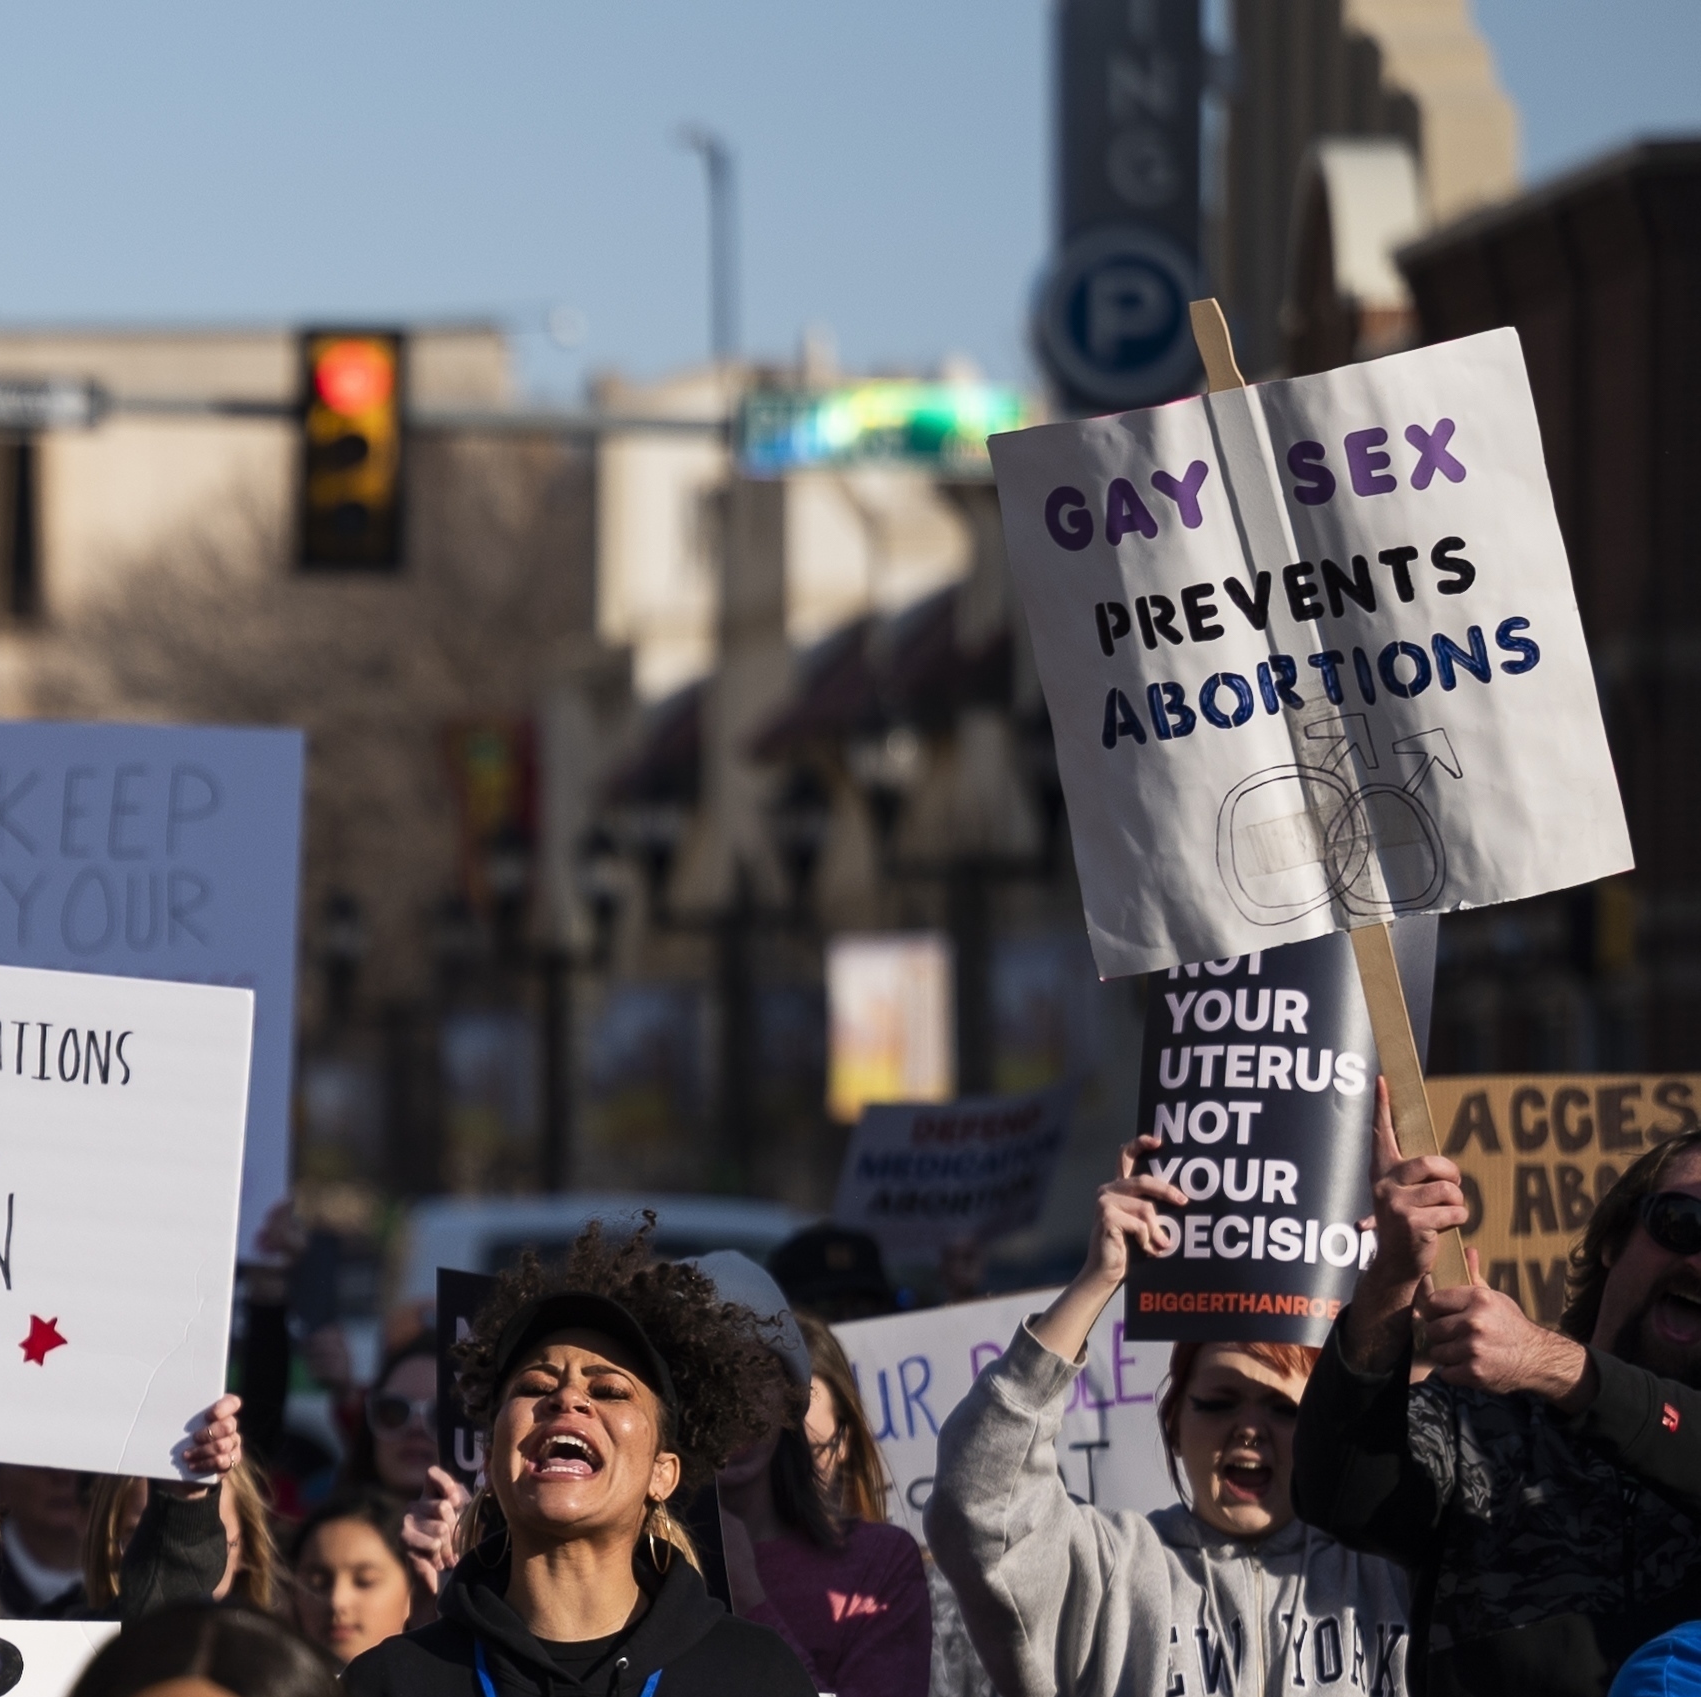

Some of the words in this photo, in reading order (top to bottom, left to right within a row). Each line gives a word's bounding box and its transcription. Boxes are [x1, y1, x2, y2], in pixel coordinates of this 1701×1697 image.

[1045, 459, 1210, 552] GAY
[1287, 416, 1467, 506] SEX
[1095, 536, 1476, 657] PREVENTS
[1102, 615, 1542, 750] ABORTIONS
[1164, 988, 1310, 1034] YOUR
[1159, 1044, 1368, 1096] UTERUS
[1153, 1100, 1263, 1145] NOT
[1147, 1157, 1299, 1205] YOUR
